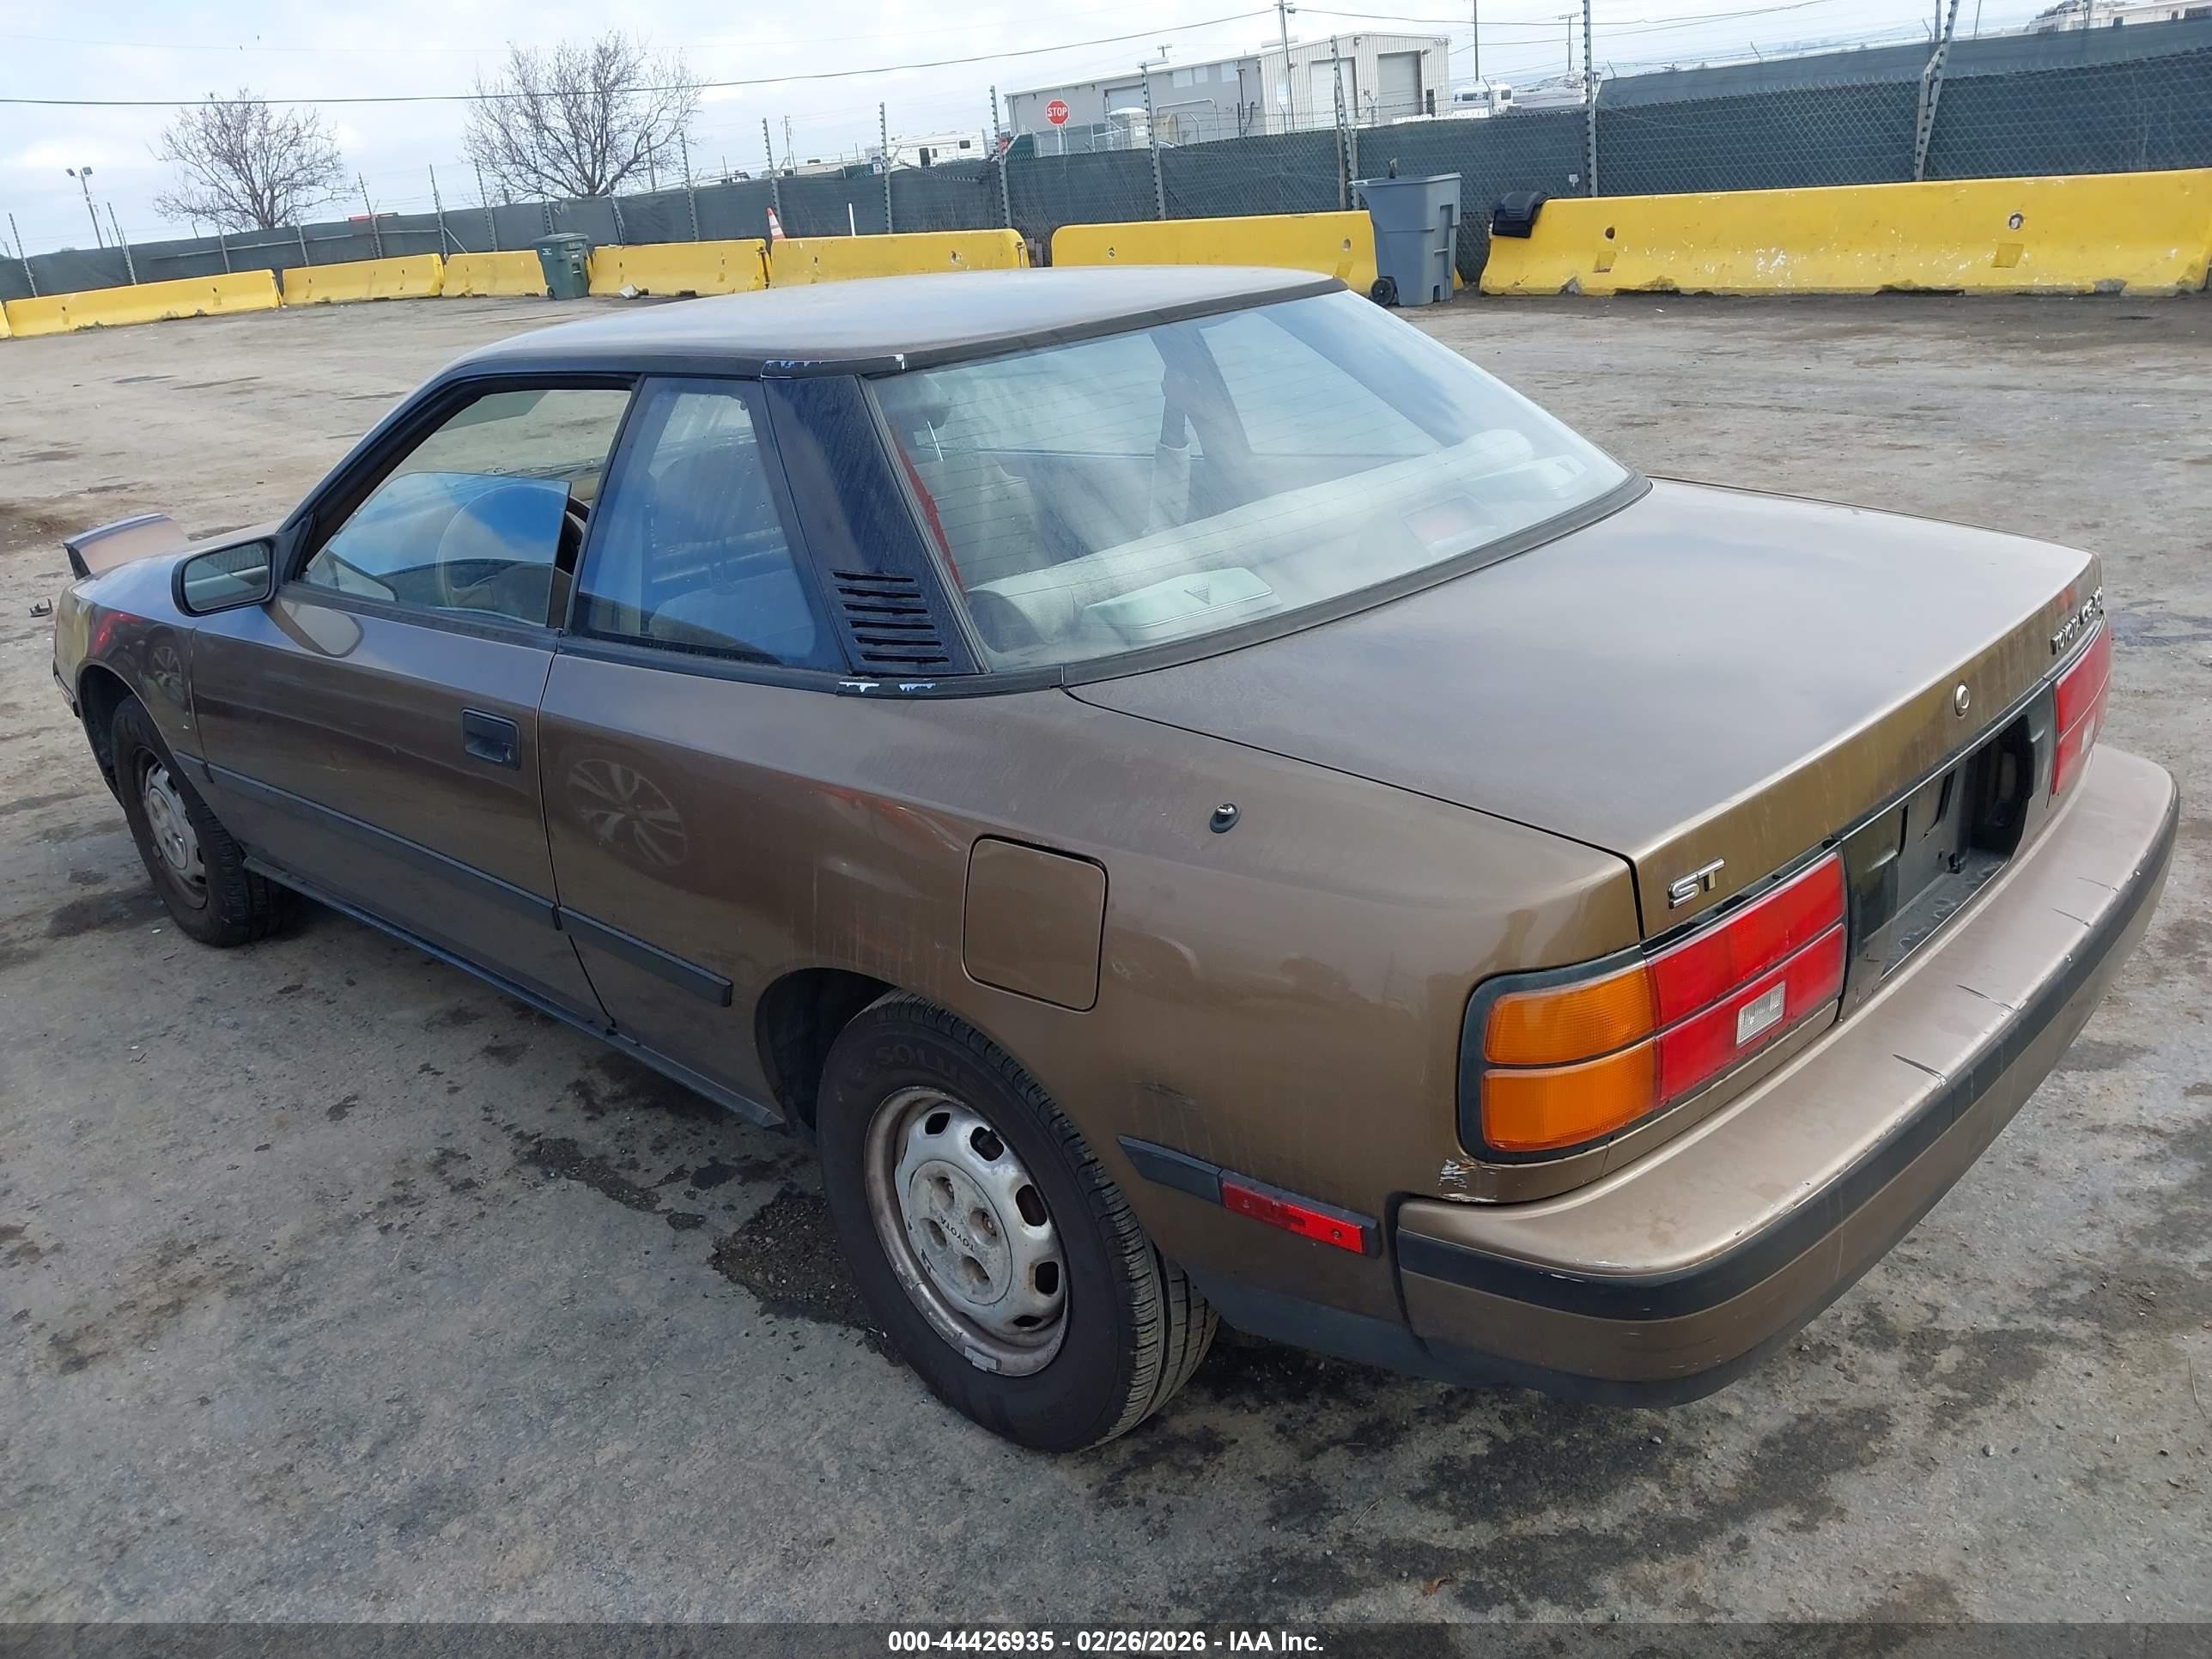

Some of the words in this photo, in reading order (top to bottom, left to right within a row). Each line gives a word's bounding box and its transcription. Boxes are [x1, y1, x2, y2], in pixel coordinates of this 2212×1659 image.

[1047, 106, 1068, 117] STOP
[2051, 614, 2081, 656] TOYOTA
[2080, 585, 2103, 625] CELC
[1668, 858, 1725, 909] ST
[940, 1215, 975, 1254] TOYOTA
